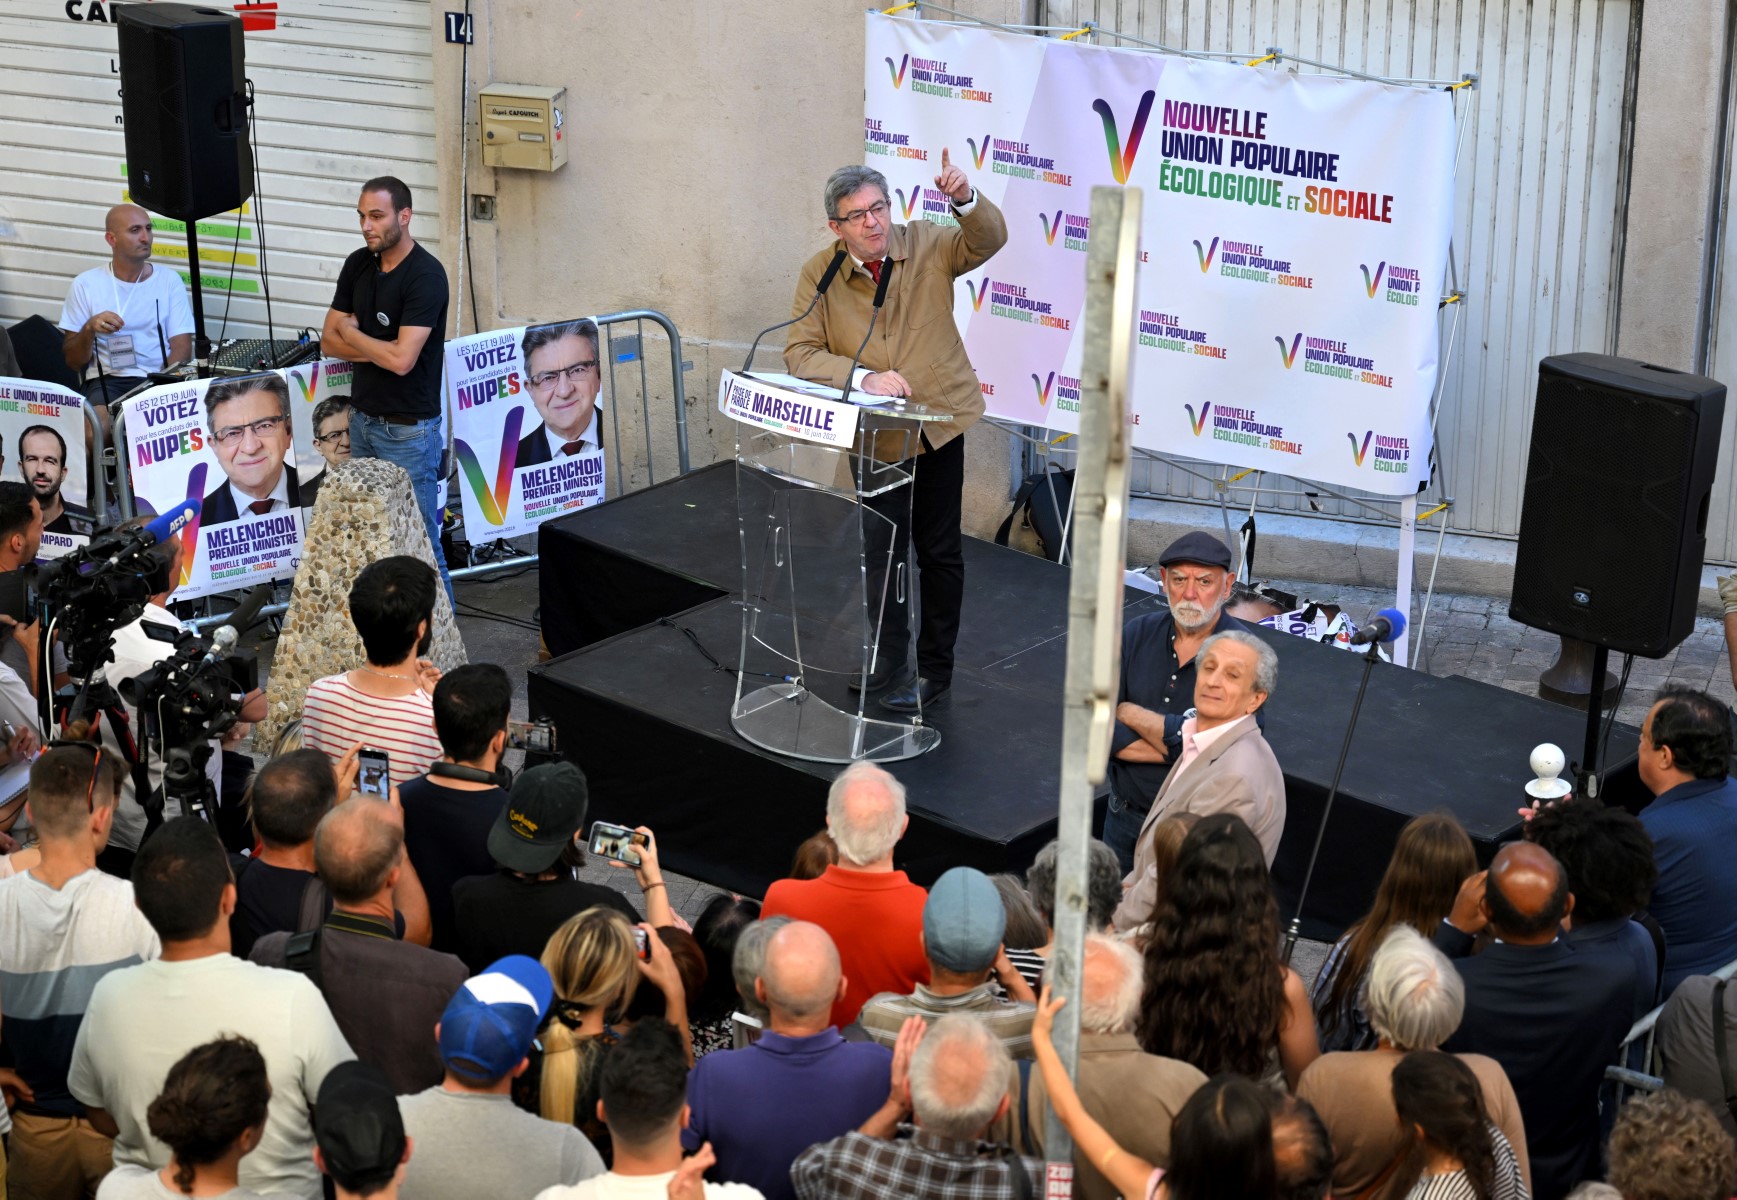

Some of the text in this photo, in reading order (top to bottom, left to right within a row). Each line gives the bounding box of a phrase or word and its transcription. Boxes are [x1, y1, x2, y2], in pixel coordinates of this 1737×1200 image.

[448, 14, 472, 42] 14
[911, 57, 947, 73] NOUVELLE
[912, 69, 973, 88] UNION POPULAIRE
[912, 80, 953, 99] ÉCOLOGIQUE
[961, 89, 992, 103] SOCIALE
[1163, 99, 1268, 140] NOUVELLE
[870, 131, 909, 146] POPULAIRE
[993, 138, 1029, 155] NOUVELLE
[897, 147, 927, 161] SOCIALE
[993, 150, 1054, 171] UNION POPULAIRE
[1161, 130, 1340, 182] UNION POPULAIRE
[992, 161, 1036, 181] ÉCOLOGIQUE
[1043, 171, 1072, 187] SOCIALE
[1159, 159, 1394, 224] ÉCOLOGIQUE ET SOCIALE
[923, 200, 946, 213] UNION
[1066, 213, 1091, 228] NOUVE
[1065, 225, 1087, 239] UNION
[1064, 237, 1088, 252] ÉCOLO
[1222, 240, 1263, 257] NOUVELLE
[1221, 251, 1291, 274] UNION POPULAIRE
[1220, 263, 1269, 284] ÉCOLOGIQUE
[1277, 274, 1313, 289] SOCIALE
[1387, 277, 1412, 292] UNION
[991, 281, 1027, 298] NOUVELLE
[991, 292, 1052, 314] UNION POPULAIRE
[990, 303, 1033, 323] ÉCOLOGIQUE
[1040, 314, 1070, 331] SOCIALE
[1140, 309, 1179, 327] NOUVELLE
[1139, 322, 1207, 344] UNION POPULAIRE
[456, 333, 515, 356] LES 12 ET 19 JUIN
[1139, 333, 1186, 353] ÉCOLOGIQUE
[1194, 344, 1227, 360] SOCIALE
[1306, 336, 1347, 353] NOUVELLE
[464, 343, 517, 372] VOTEZ
[1305, 348, 1374, 371] UNION POPULAIRE
[325, 362, 352, 376] NOUVE
[456, 379, 468, 388] pour
[478, 369, 503, 381] candidats
[1304, 360, 1353, 380] ÉCOLOGIQUE
[1361, 372, 1393, 388] SOCIALE
[326, 373, 352, 388] ÉCOLO
[1058, 375, 1082, 390] NOUVE
[14, 389, 37, 402] UNION
[40, 392, 81, 408] POPULAIRE
[135, 387, 197, 412] LES 12 ET 19 JUIN
[457, 372, 520, 411] NUPES
[732, 385, 745, 397] PRISE
[745, 389, 752, 399] DE
[1057, 386, 1080, 400] UNION
[27, 403, 60, 417] SOCIALE
[730, 394, 750, 410] PAROLE
[752, 392, 835, 431] MARSEILLE
[1057, 396, 1080, 413] ÉCOLO
[143, 398, 199, 427] VOTEZ
[1214, 405, 1255, 421] NOUVELLE
[135, 434, 148, 443] pour
[158, 425, 185, 437] candidats
[1213, 416, 1283, 438] UNION POPULAIRE
[136, 427, 203, 467] NUPES
[1213, 427, 1261, 447] ÉCOLOGIQUE
[1269, 439, 1302, 455] SOCIALE
[1374, 446, 1401, 461] UNION
[521, 456, 602, 490] MÉLENCHON
[523, 473, 603, 501] PREMIER MINISTRE
[524, 488, 598, 512] NOUVELLE UNION POPULAIRE
[524, 506, 557, 519] ÉCOLOGIQUE
[563, 499, 584, 510] SOCIALE
[169, 517, 185, 533] AFP
[206, 515, 296, 550] MÉLENCHON
[41, 534, 73, 547] MPARD
[209, 532, 298, 562] PREMIER MINISTRE
[210, 549, 292, 572] NOUVELLE UNION POPULAIRE
[211, 568, 247, 580] ÉCOLOGIQUE
[253, 561, 277, 571] SOCIALE
